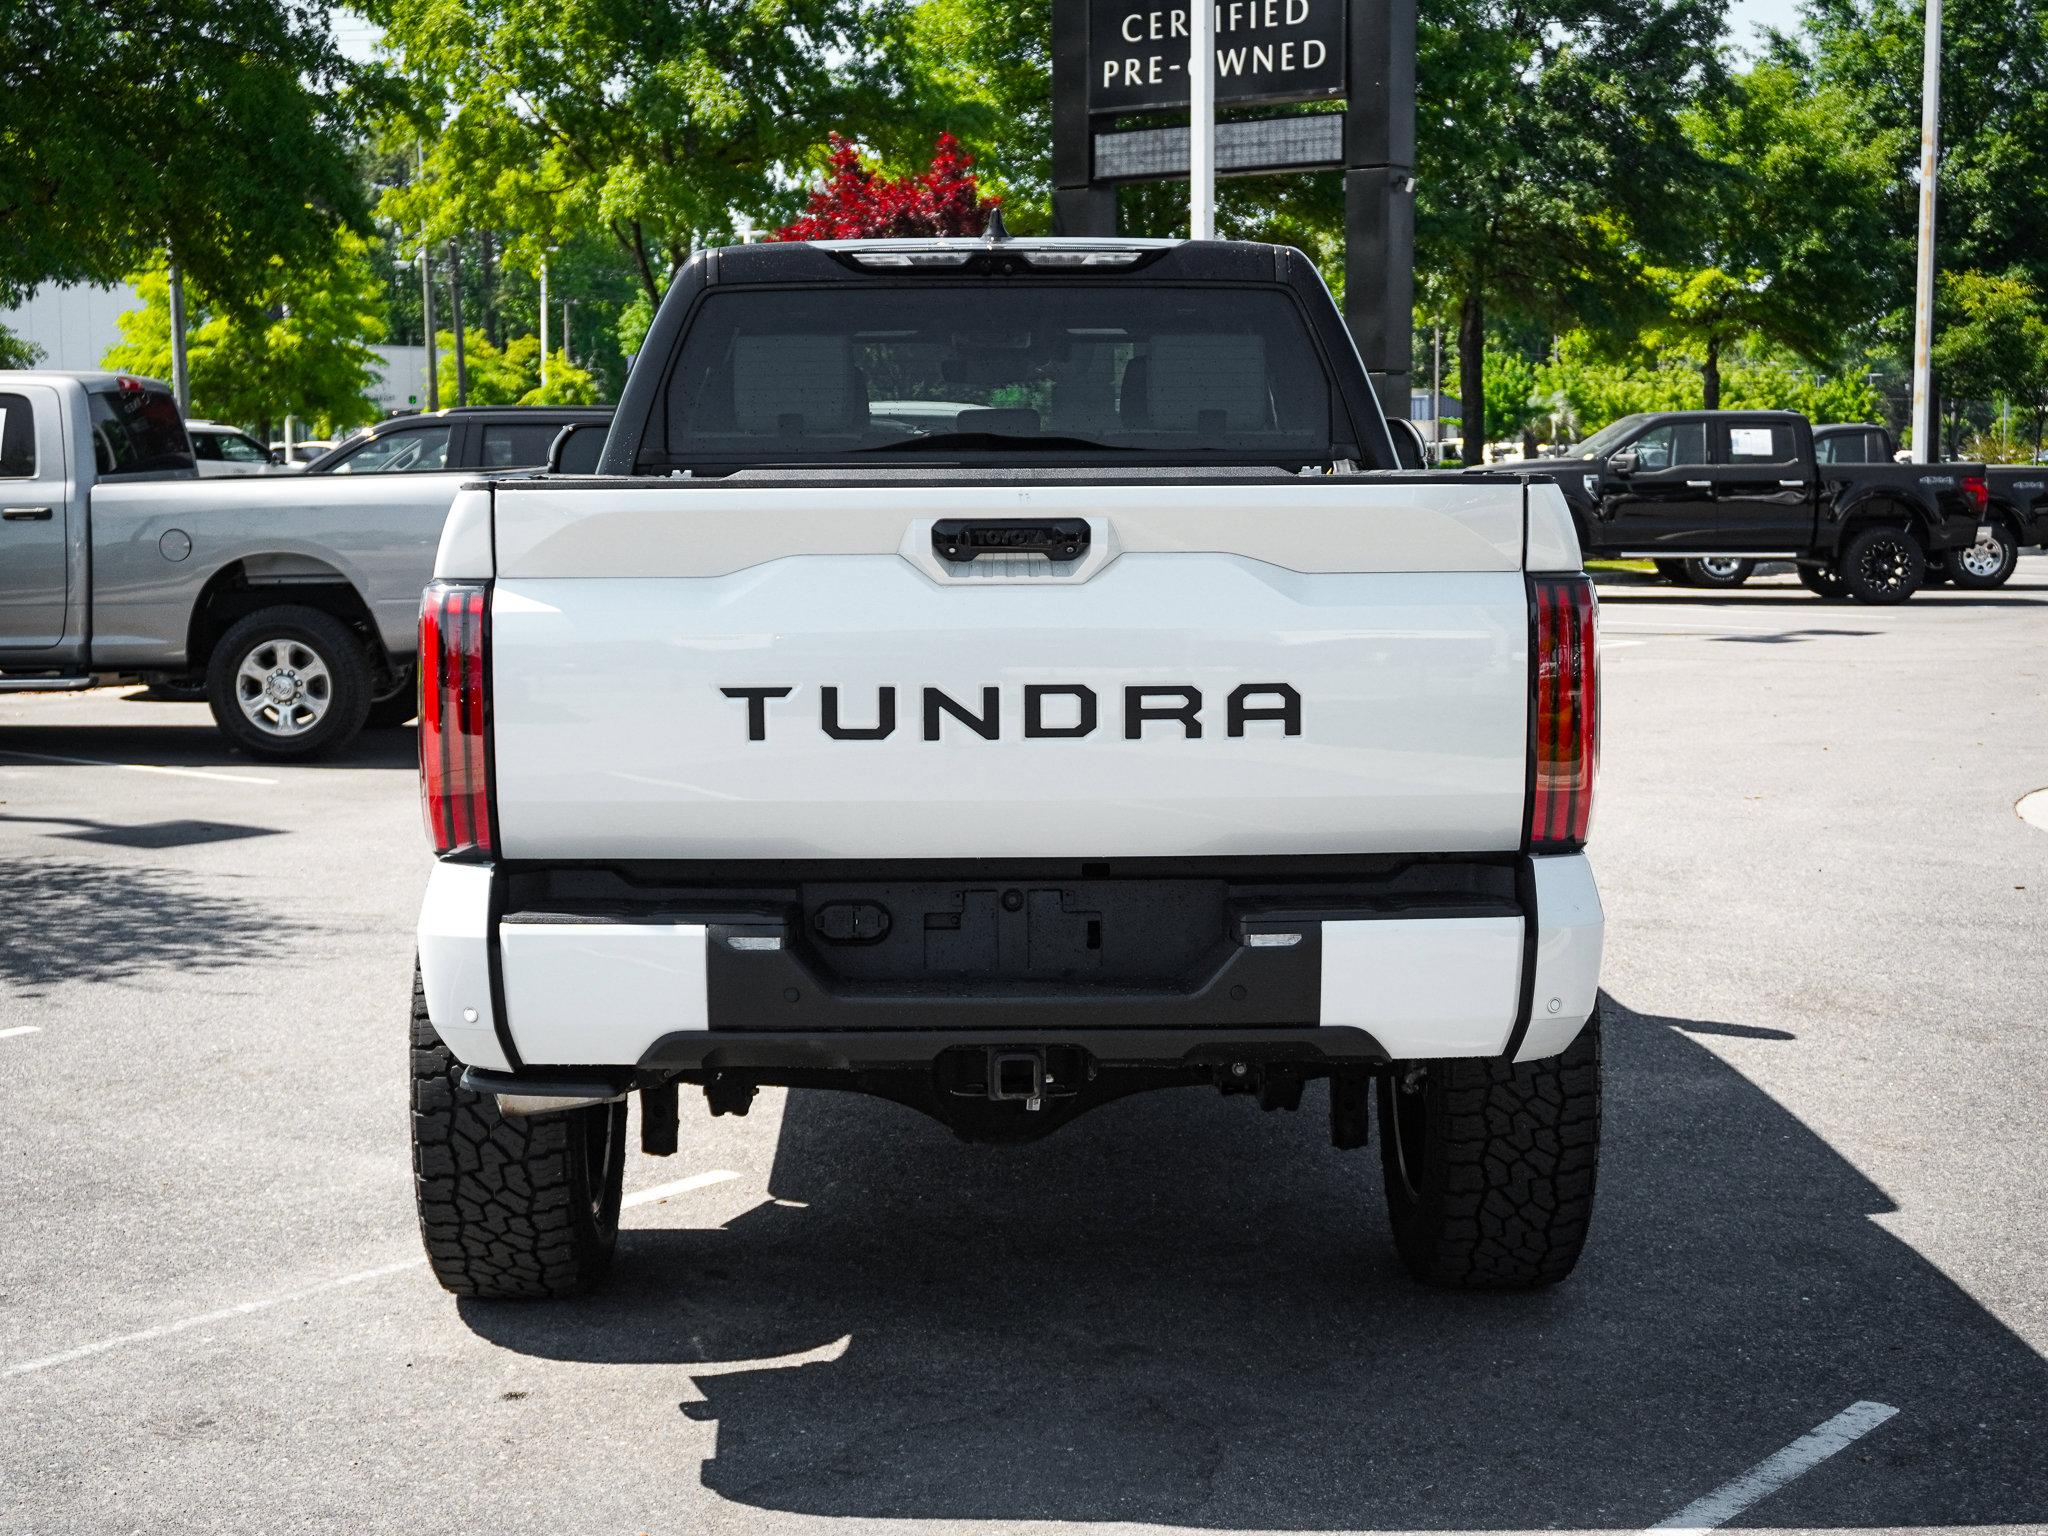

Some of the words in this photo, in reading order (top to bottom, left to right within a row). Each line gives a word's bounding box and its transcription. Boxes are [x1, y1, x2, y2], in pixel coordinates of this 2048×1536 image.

[1121, 0, 1309, 42] CERIFIED
[1103, 39, 1326, 88] PRE-WNED
[975, 529, 1047, 545] TOYOTA
[719, 682, 1302, 741] TUNDRA
